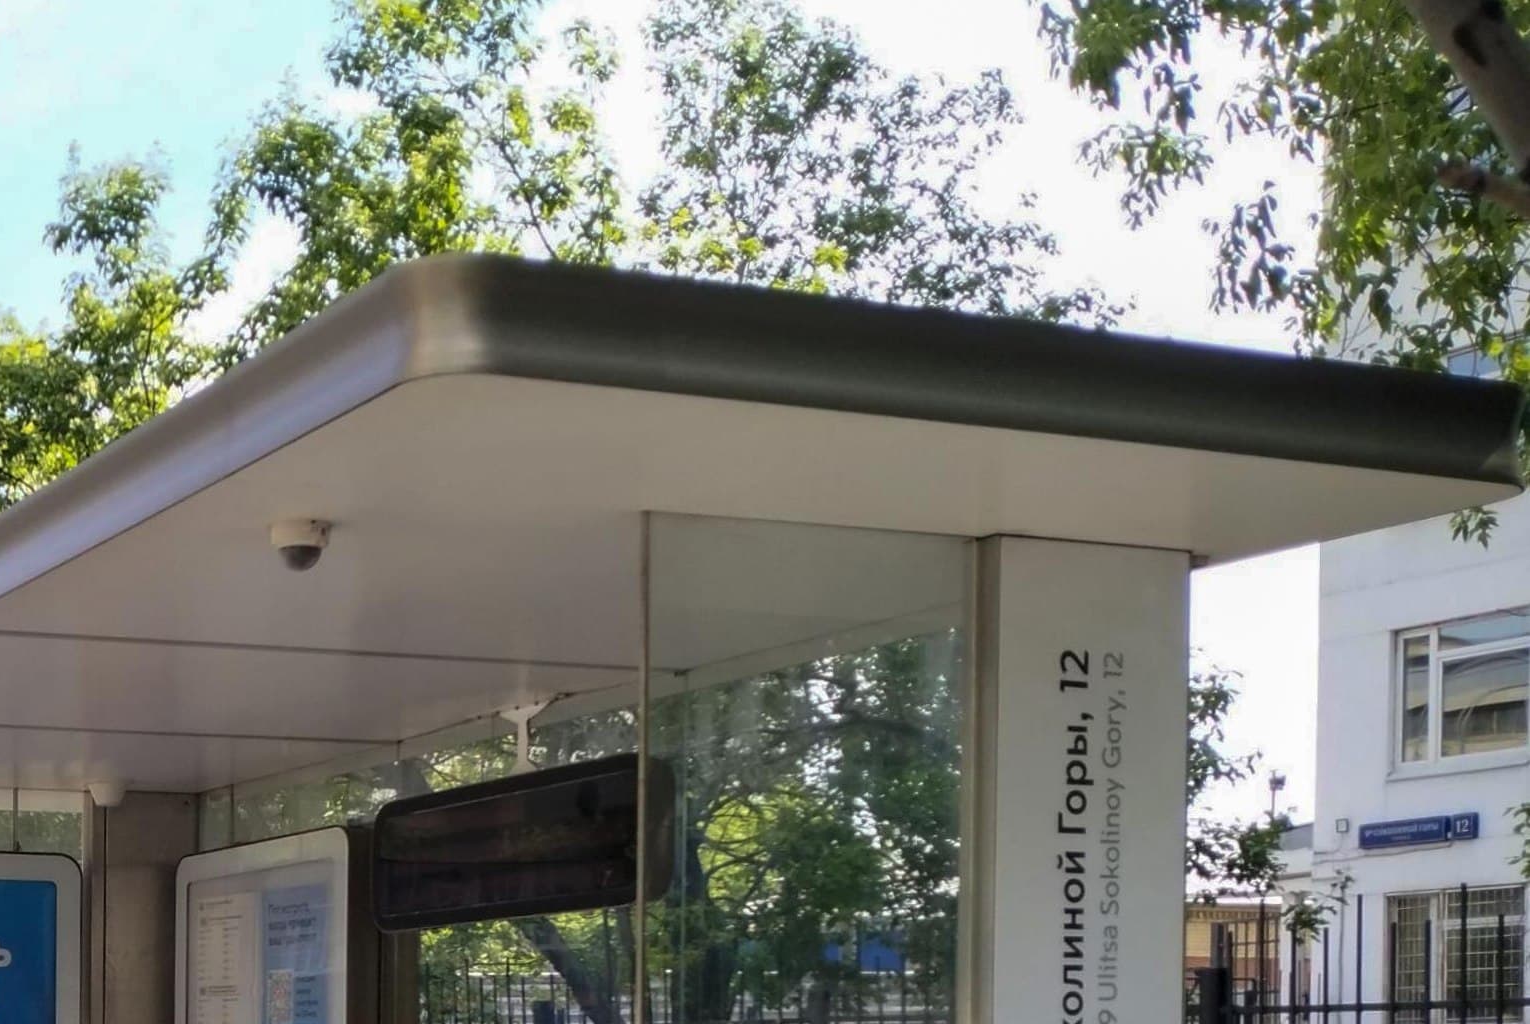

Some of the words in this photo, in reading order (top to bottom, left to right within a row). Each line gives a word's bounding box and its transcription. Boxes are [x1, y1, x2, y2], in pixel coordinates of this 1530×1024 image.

[1059, 649, 1090, 693] 12
[1103, 651, 1124, 680] 12
[1057, 711, 1094, 834] Горы,
[1099, 778, 1126, 916] Sokolinoy
[1456, 819, 1469, 833] 12
[1096, 924, 1120, 1001] Ulitsa
